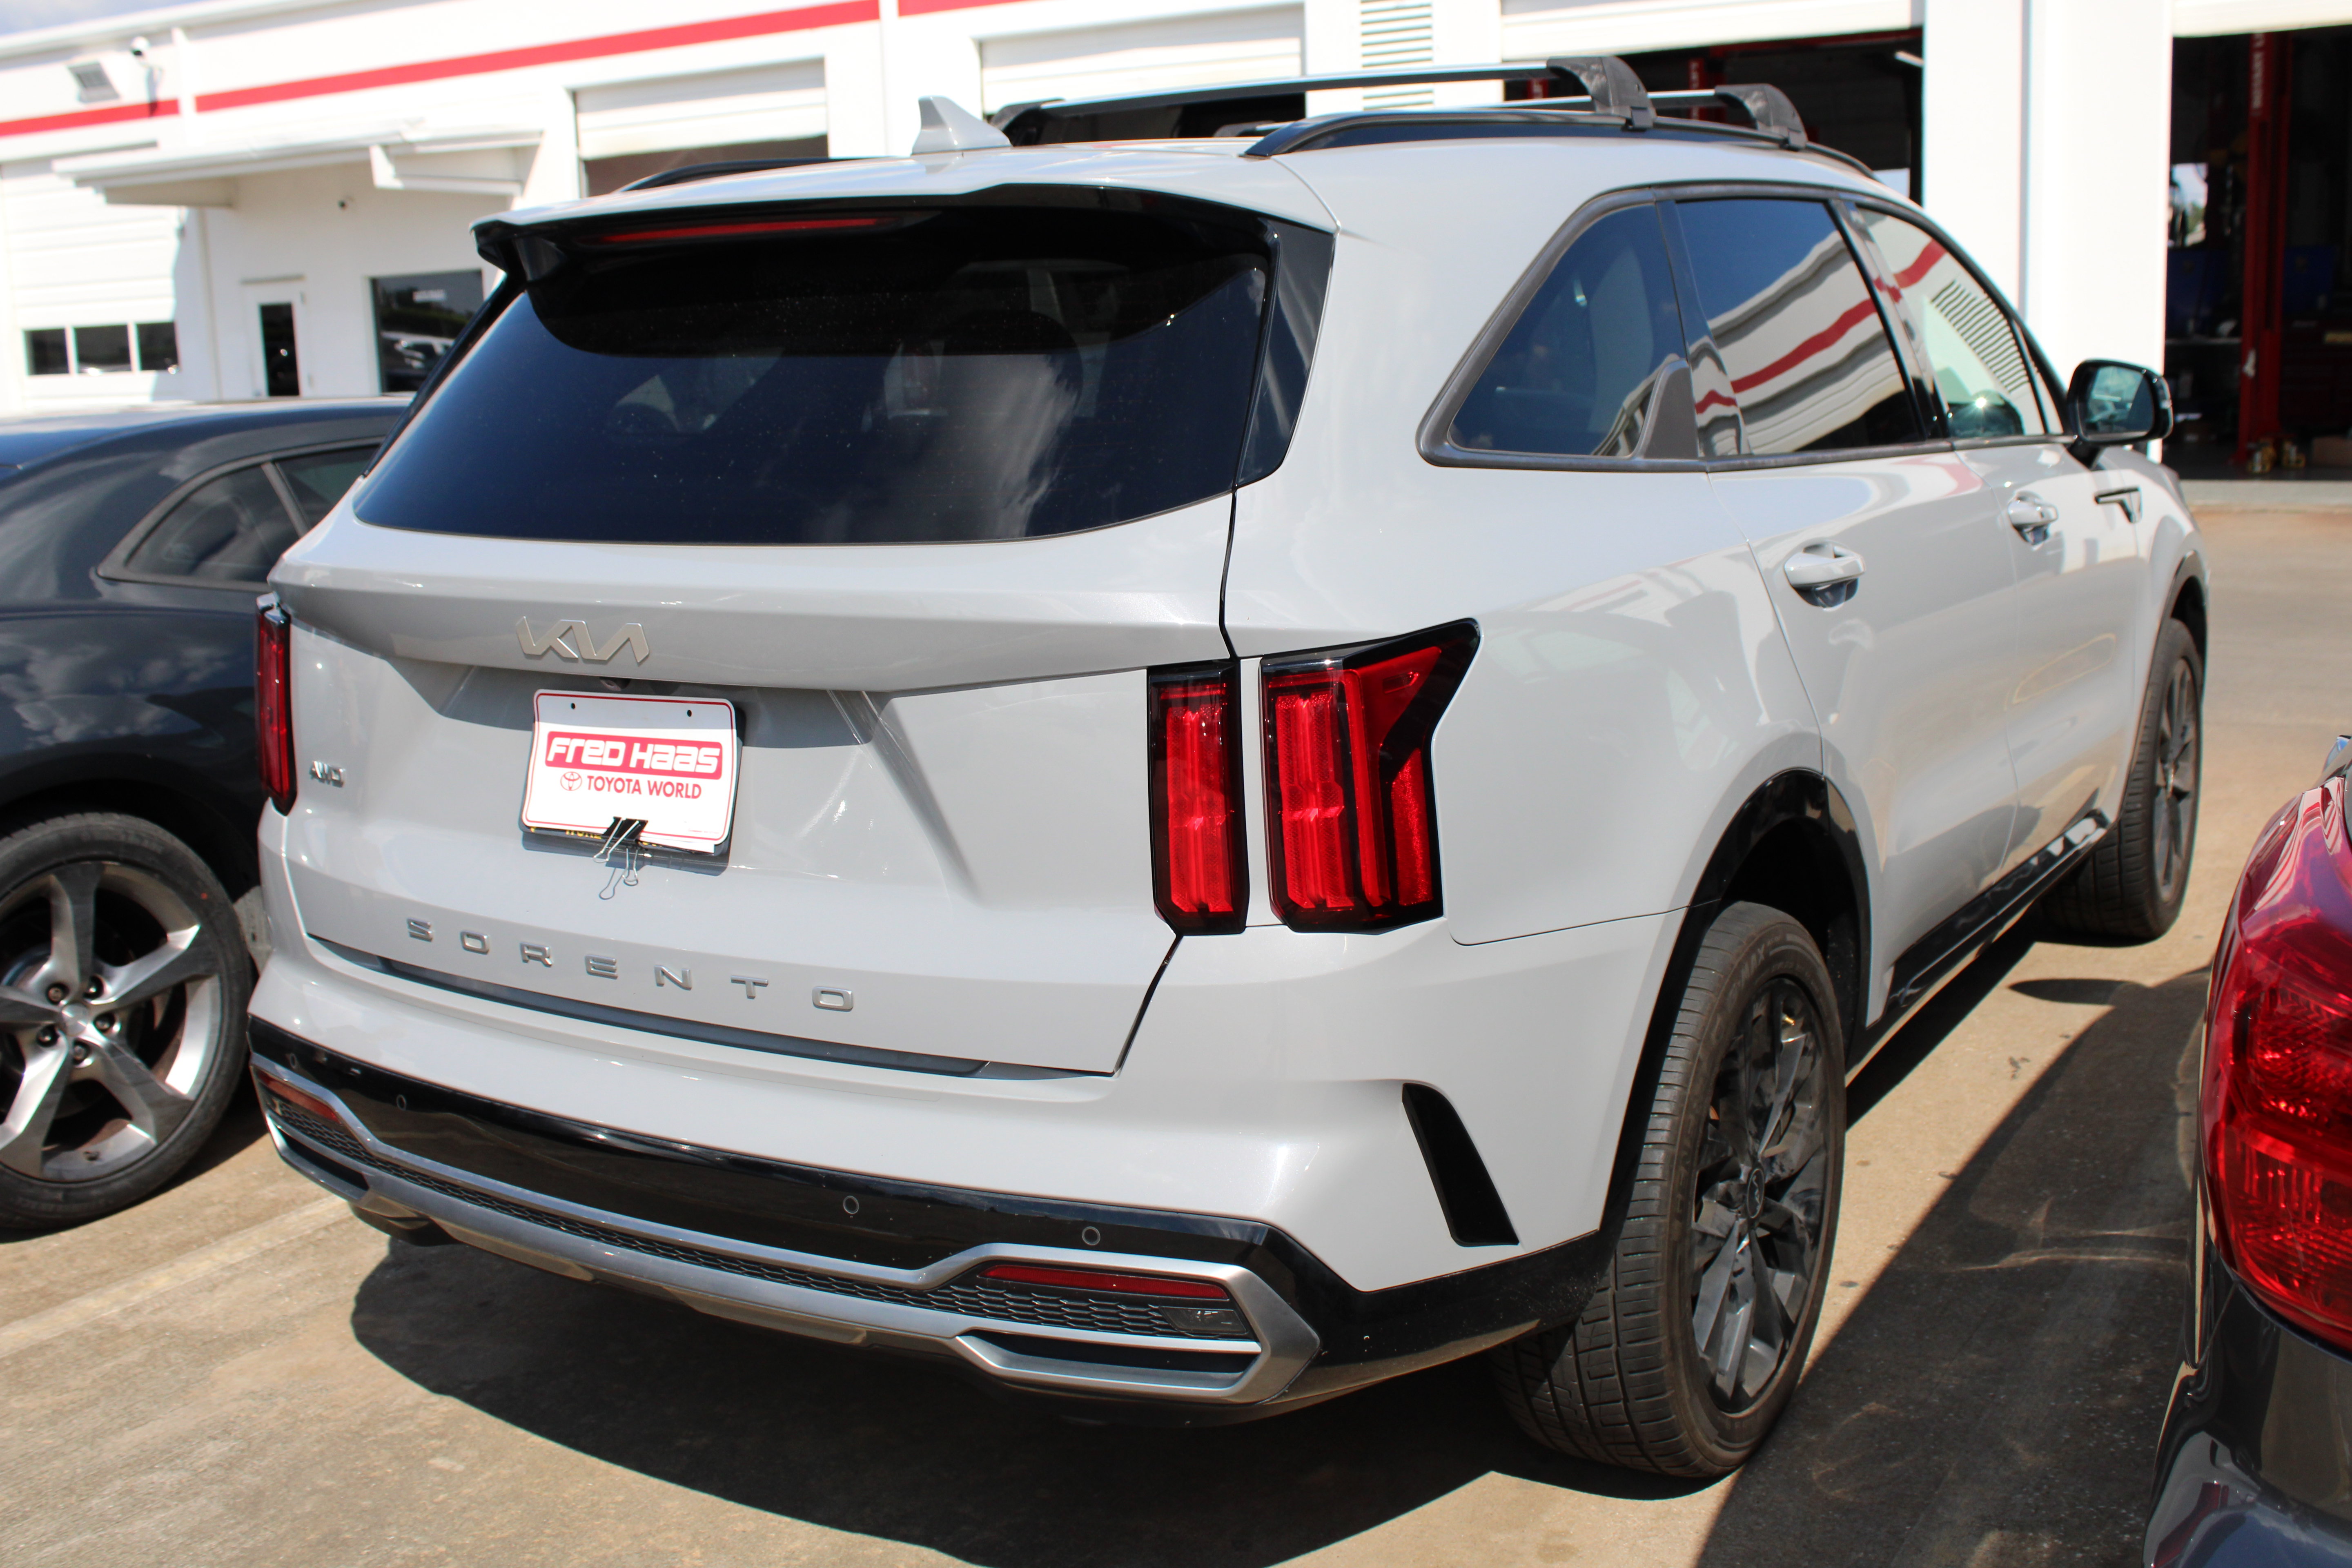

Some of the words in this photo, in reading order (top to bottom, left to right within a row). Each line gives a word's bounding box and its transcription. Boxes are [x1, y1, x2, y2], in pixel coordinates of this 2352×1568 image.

[515, 616, 649, 663] KIA
[587, 775, 642, 795] TOYOTA
[647, 780, 702, 799] WORLD
[408, 918, 853, 1011] SORENTO
